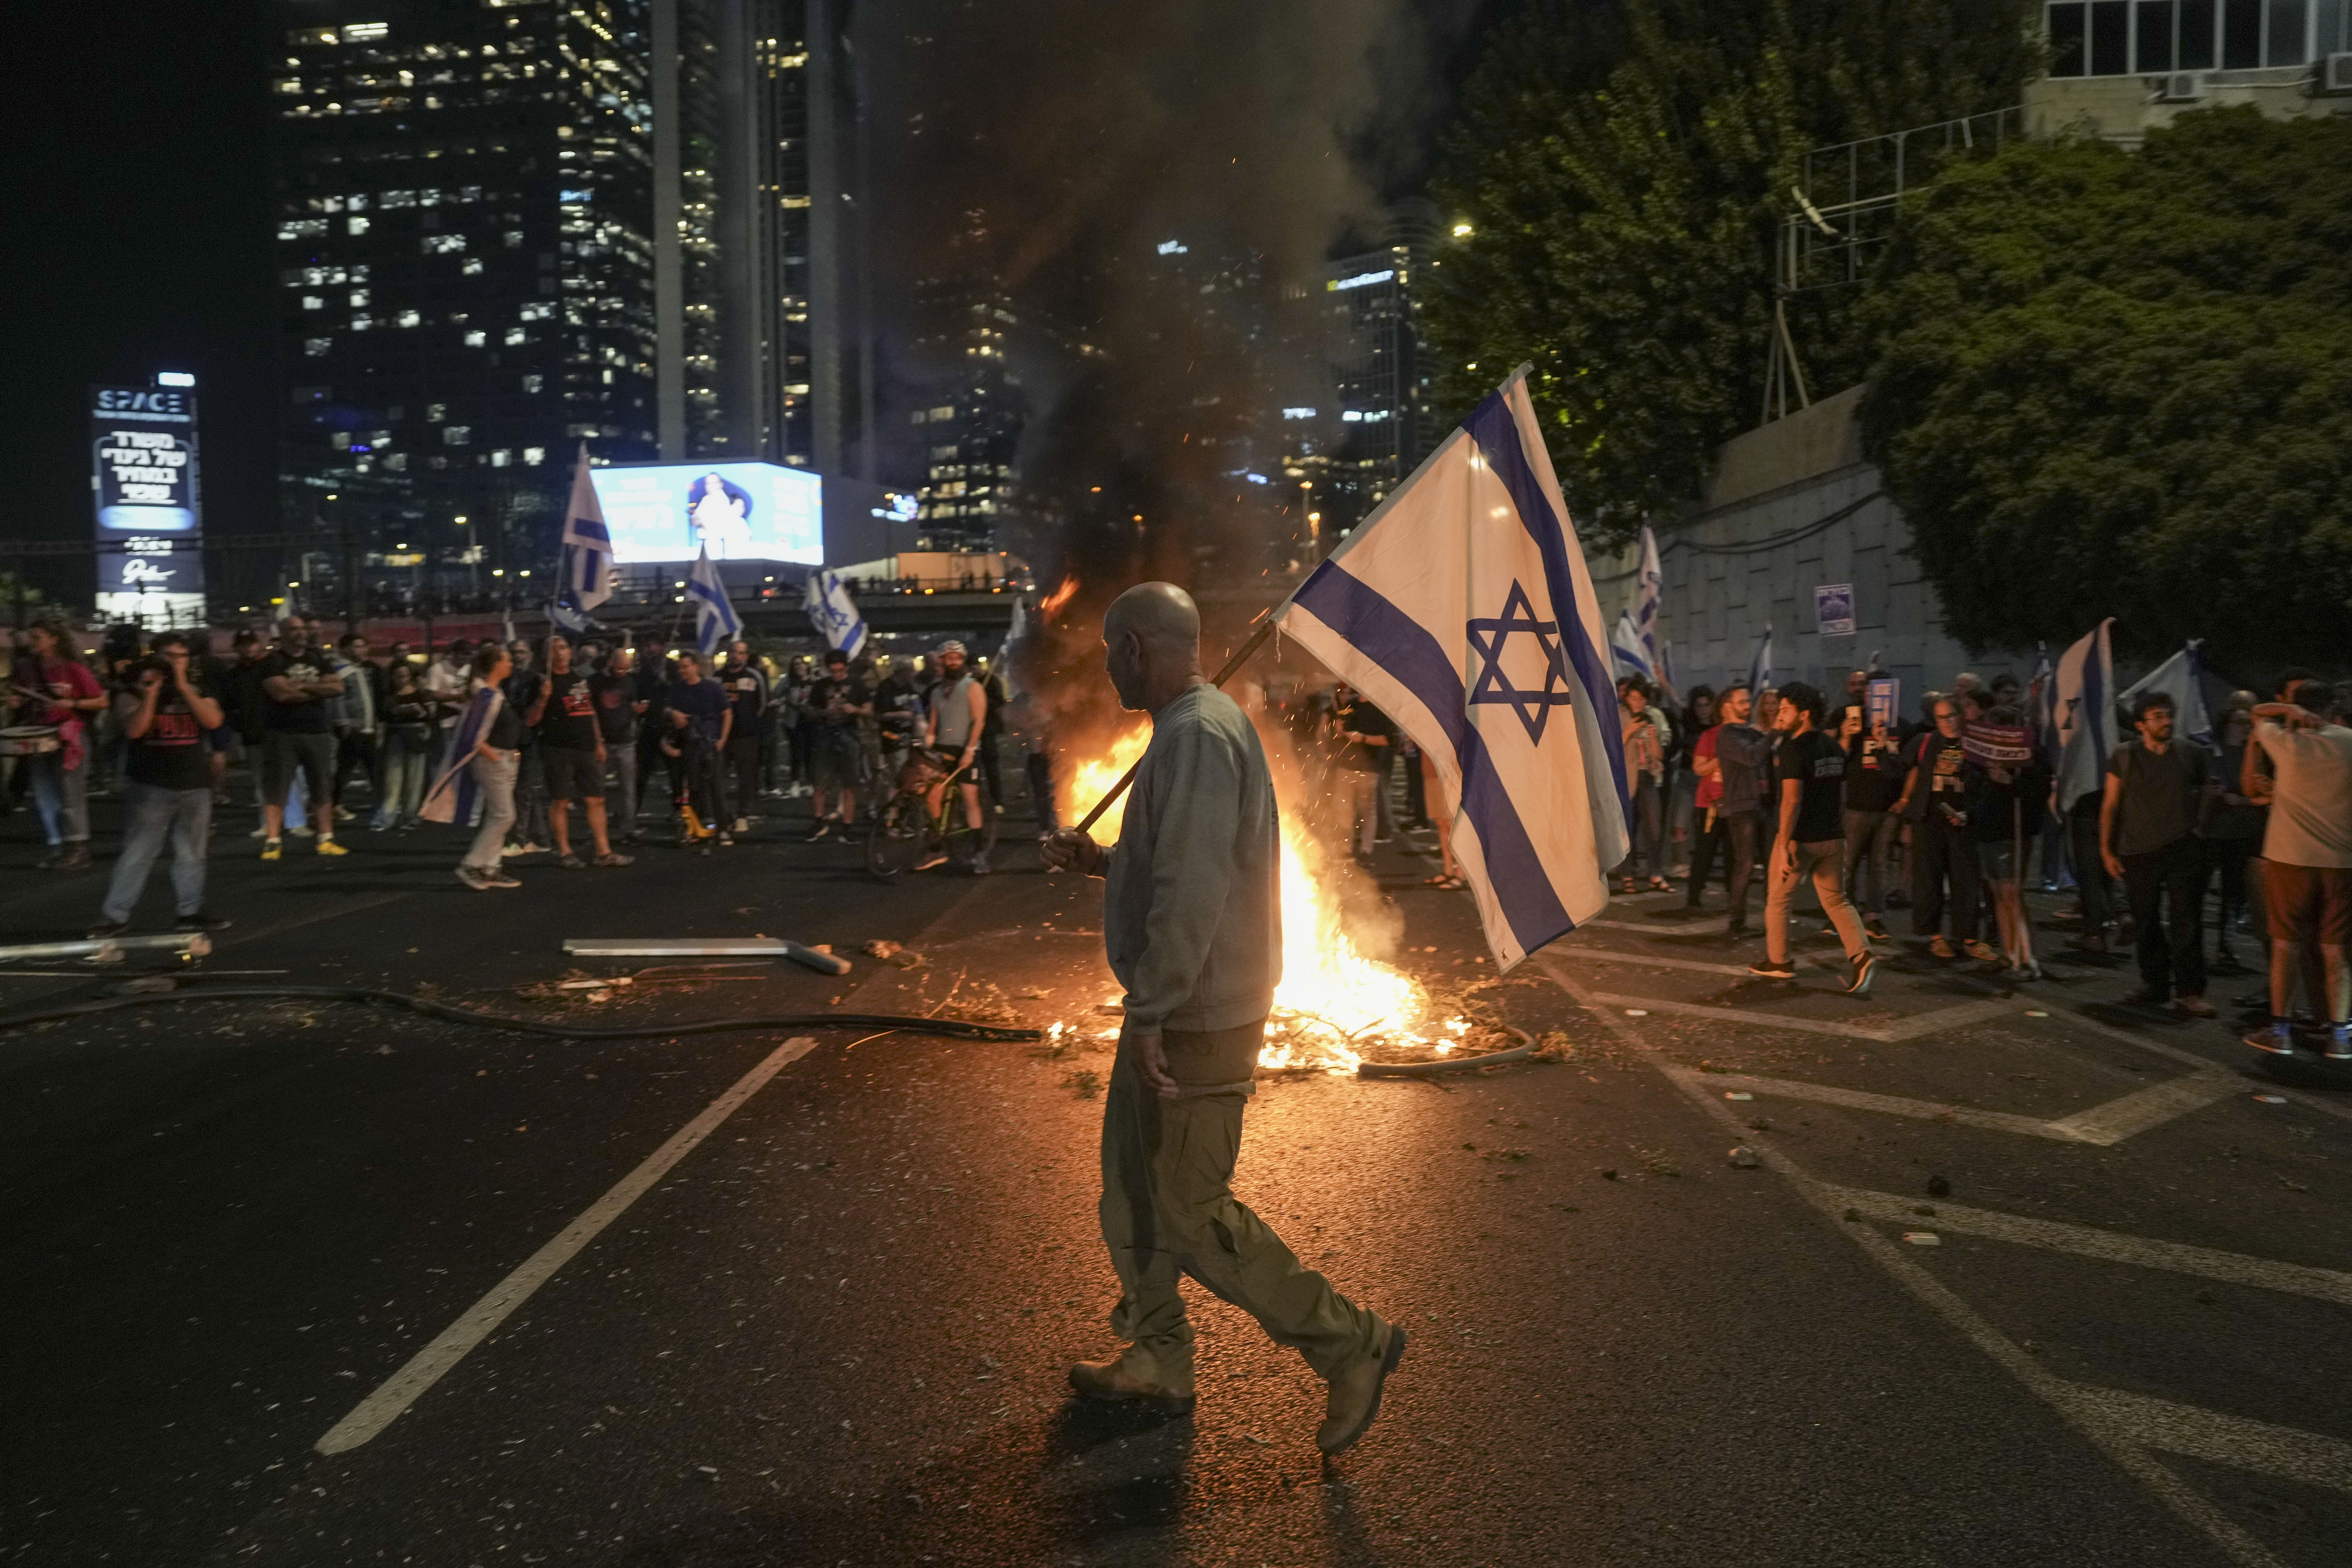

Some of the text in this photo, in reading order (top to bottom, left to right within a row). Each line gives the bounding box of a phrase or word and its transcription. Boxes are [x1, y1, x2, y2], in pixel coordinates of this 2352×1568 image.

[98, 389, 183, 413] SPACE
[110, 431, 175, 449] משרד
[151, 447, 187, 467] של
[110, 465, 179, 484] במחיר
